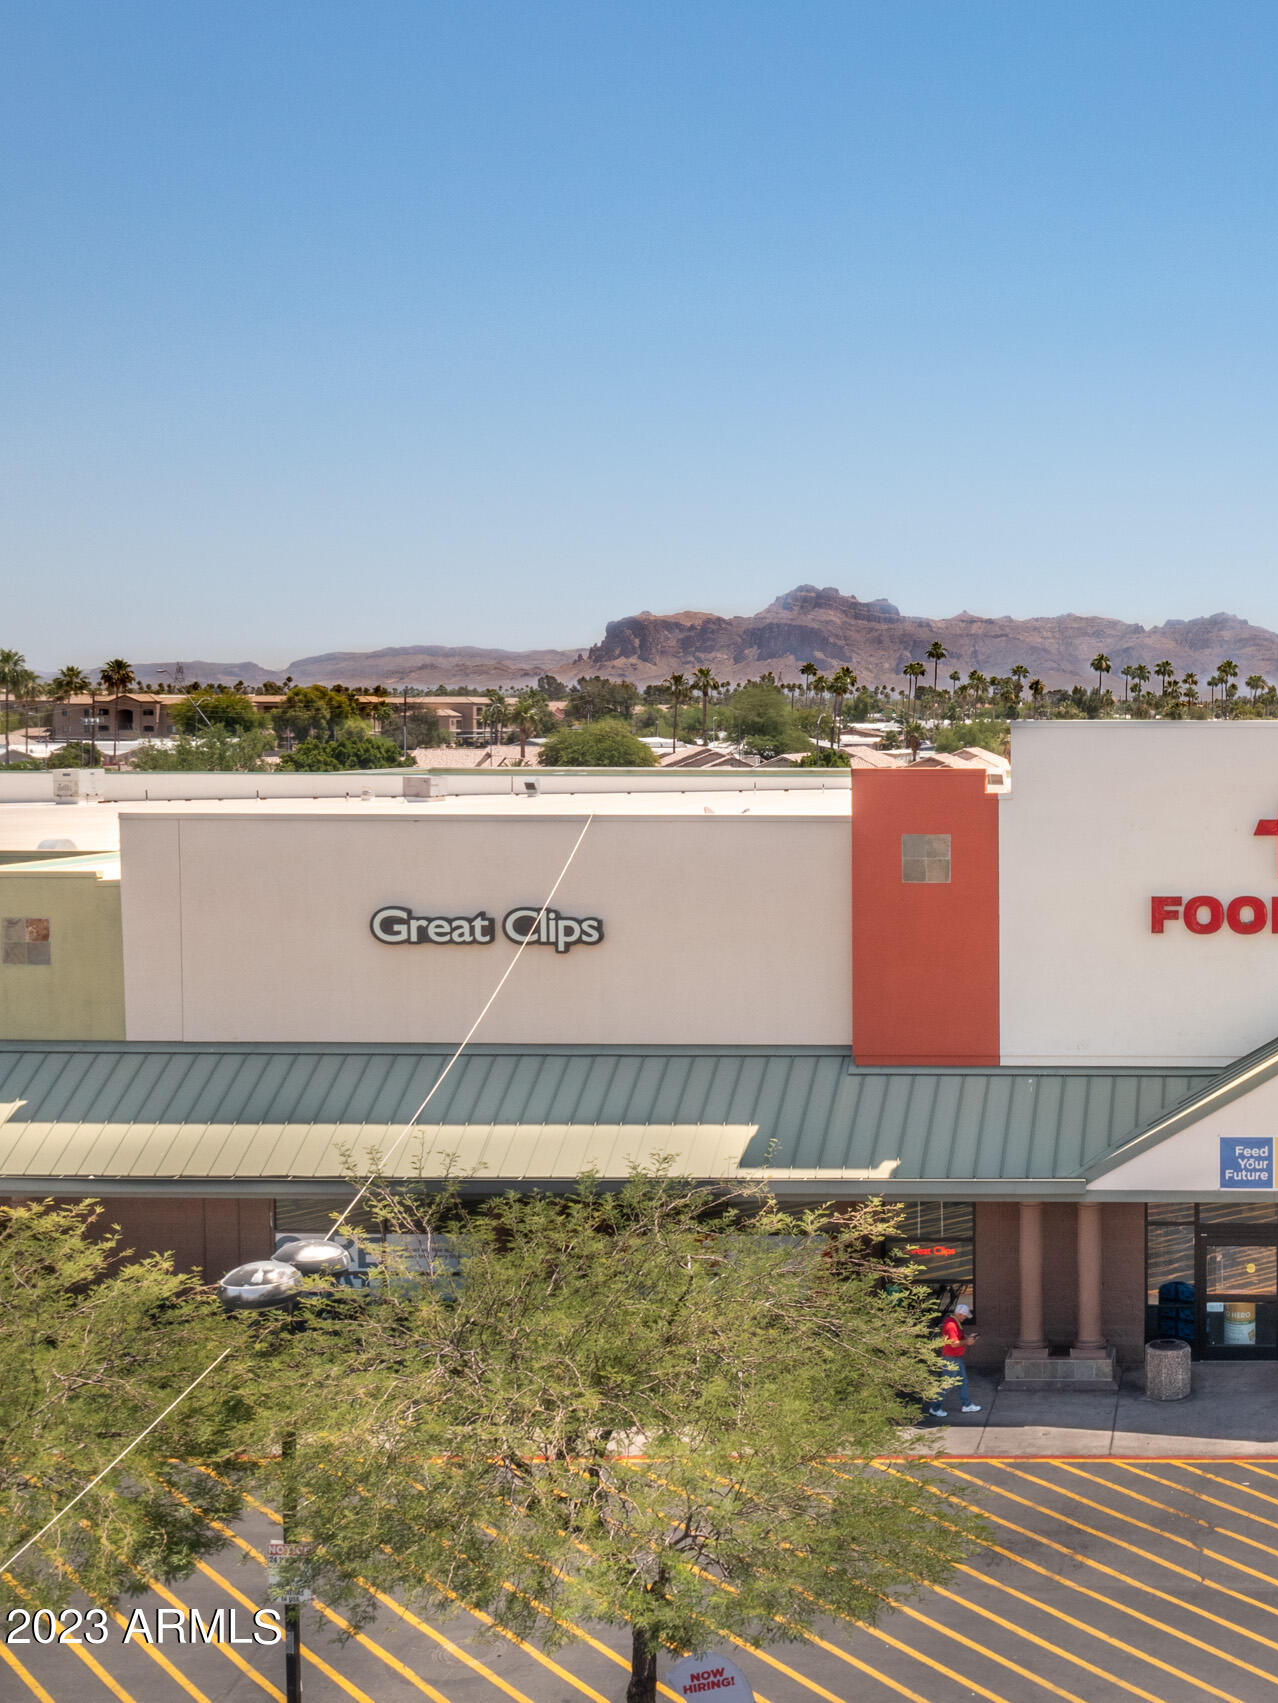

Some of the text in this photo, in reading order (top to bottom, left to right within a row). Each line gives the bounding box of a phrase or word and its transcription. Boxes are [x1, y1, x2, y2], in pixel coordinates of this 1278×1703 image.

[371, 907, 603, 952] Great Clips
[1235, 1146, 1269, 1157] Feed
[1238, 1158, 1269, 1169] Your
[1225, 1169, 1269, 1181] Future
[690, 1667, 725, 1683] NOW
[683, 1676, 735, 1694] HIRING!
